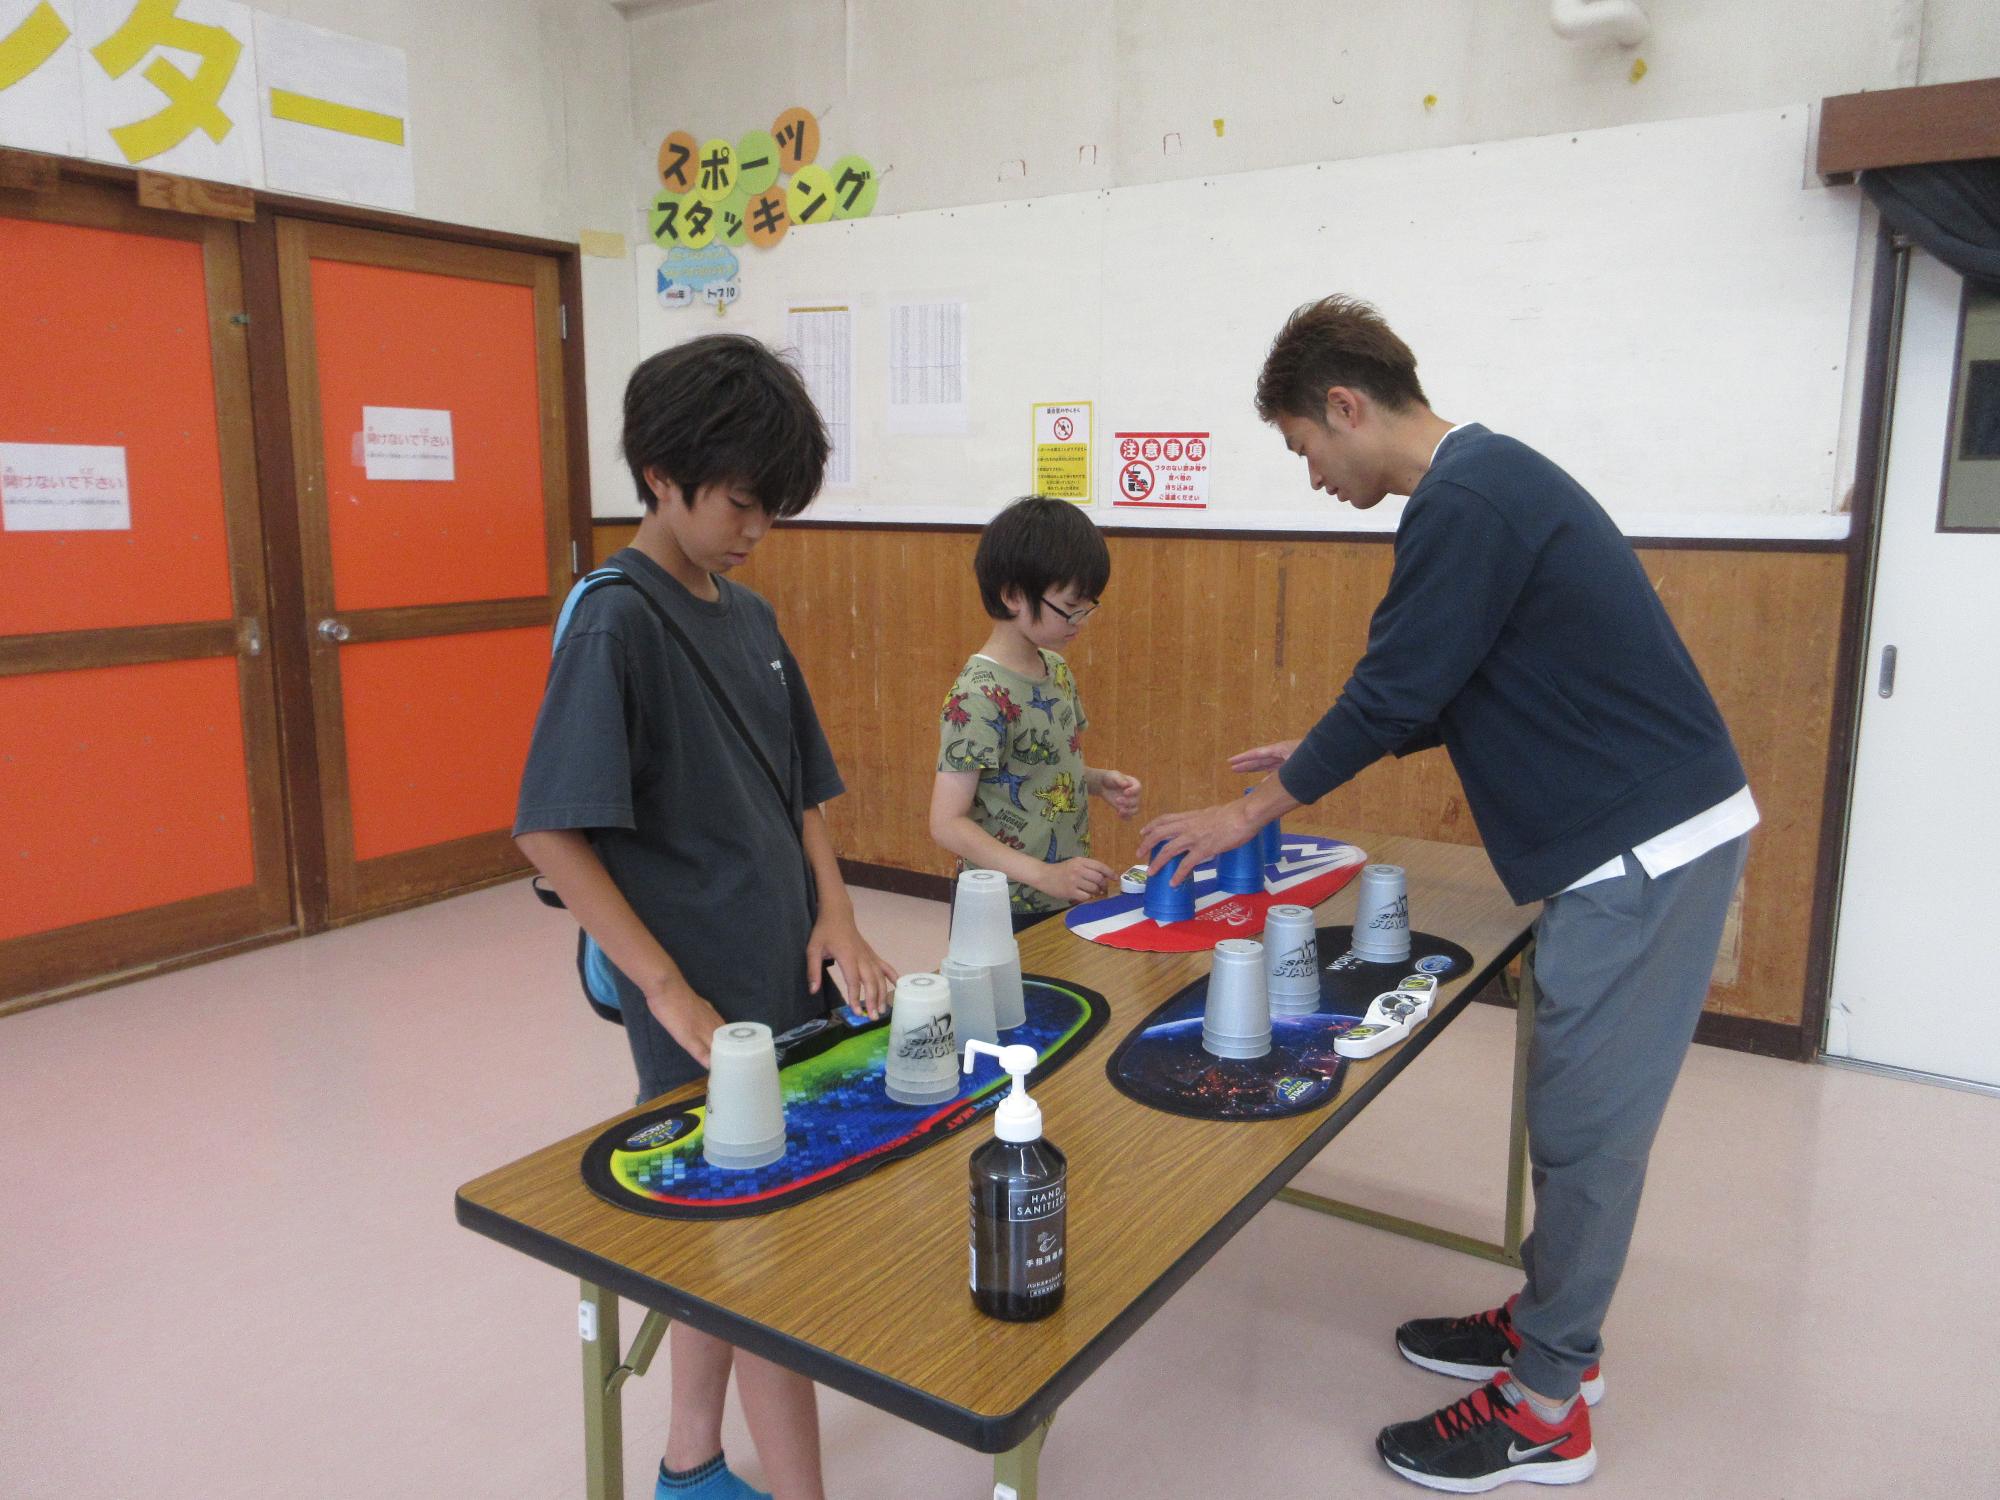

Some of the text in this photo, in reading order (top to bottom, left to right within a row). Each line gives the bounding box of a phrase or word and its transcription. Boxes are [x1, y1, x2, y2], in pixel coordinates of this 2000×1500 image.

[663, 120, 806, 192] スポーツ
[654, 166, 871, 240] スタッキング
[1121, 440, 1204, 459] 注意事項
[1031, 1186, 1061, 1204] HAND
